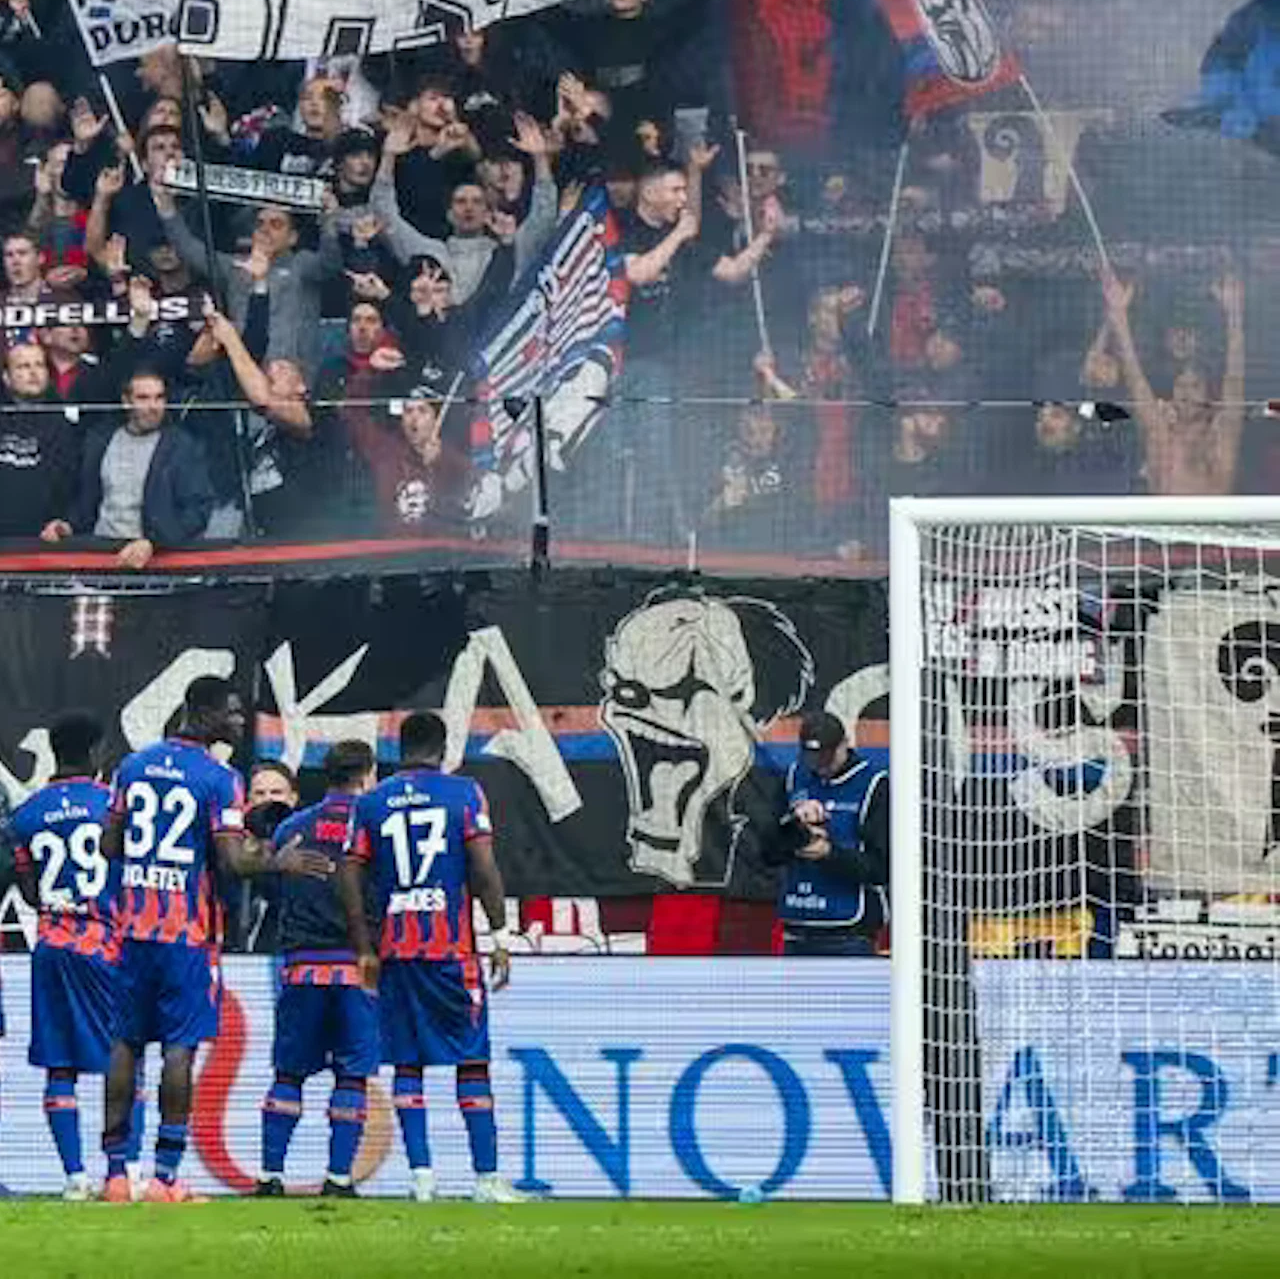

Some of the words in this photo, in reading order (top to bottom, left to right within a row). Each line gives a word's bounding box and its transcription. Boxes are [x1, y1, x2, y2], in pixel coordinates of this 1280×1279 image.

[124, 781, 198, 863] 32
[379, 806, 448, 888] 17
[31, 822, 109, 908] 29
[510, 1041, 1280, 1203] NOVAR
